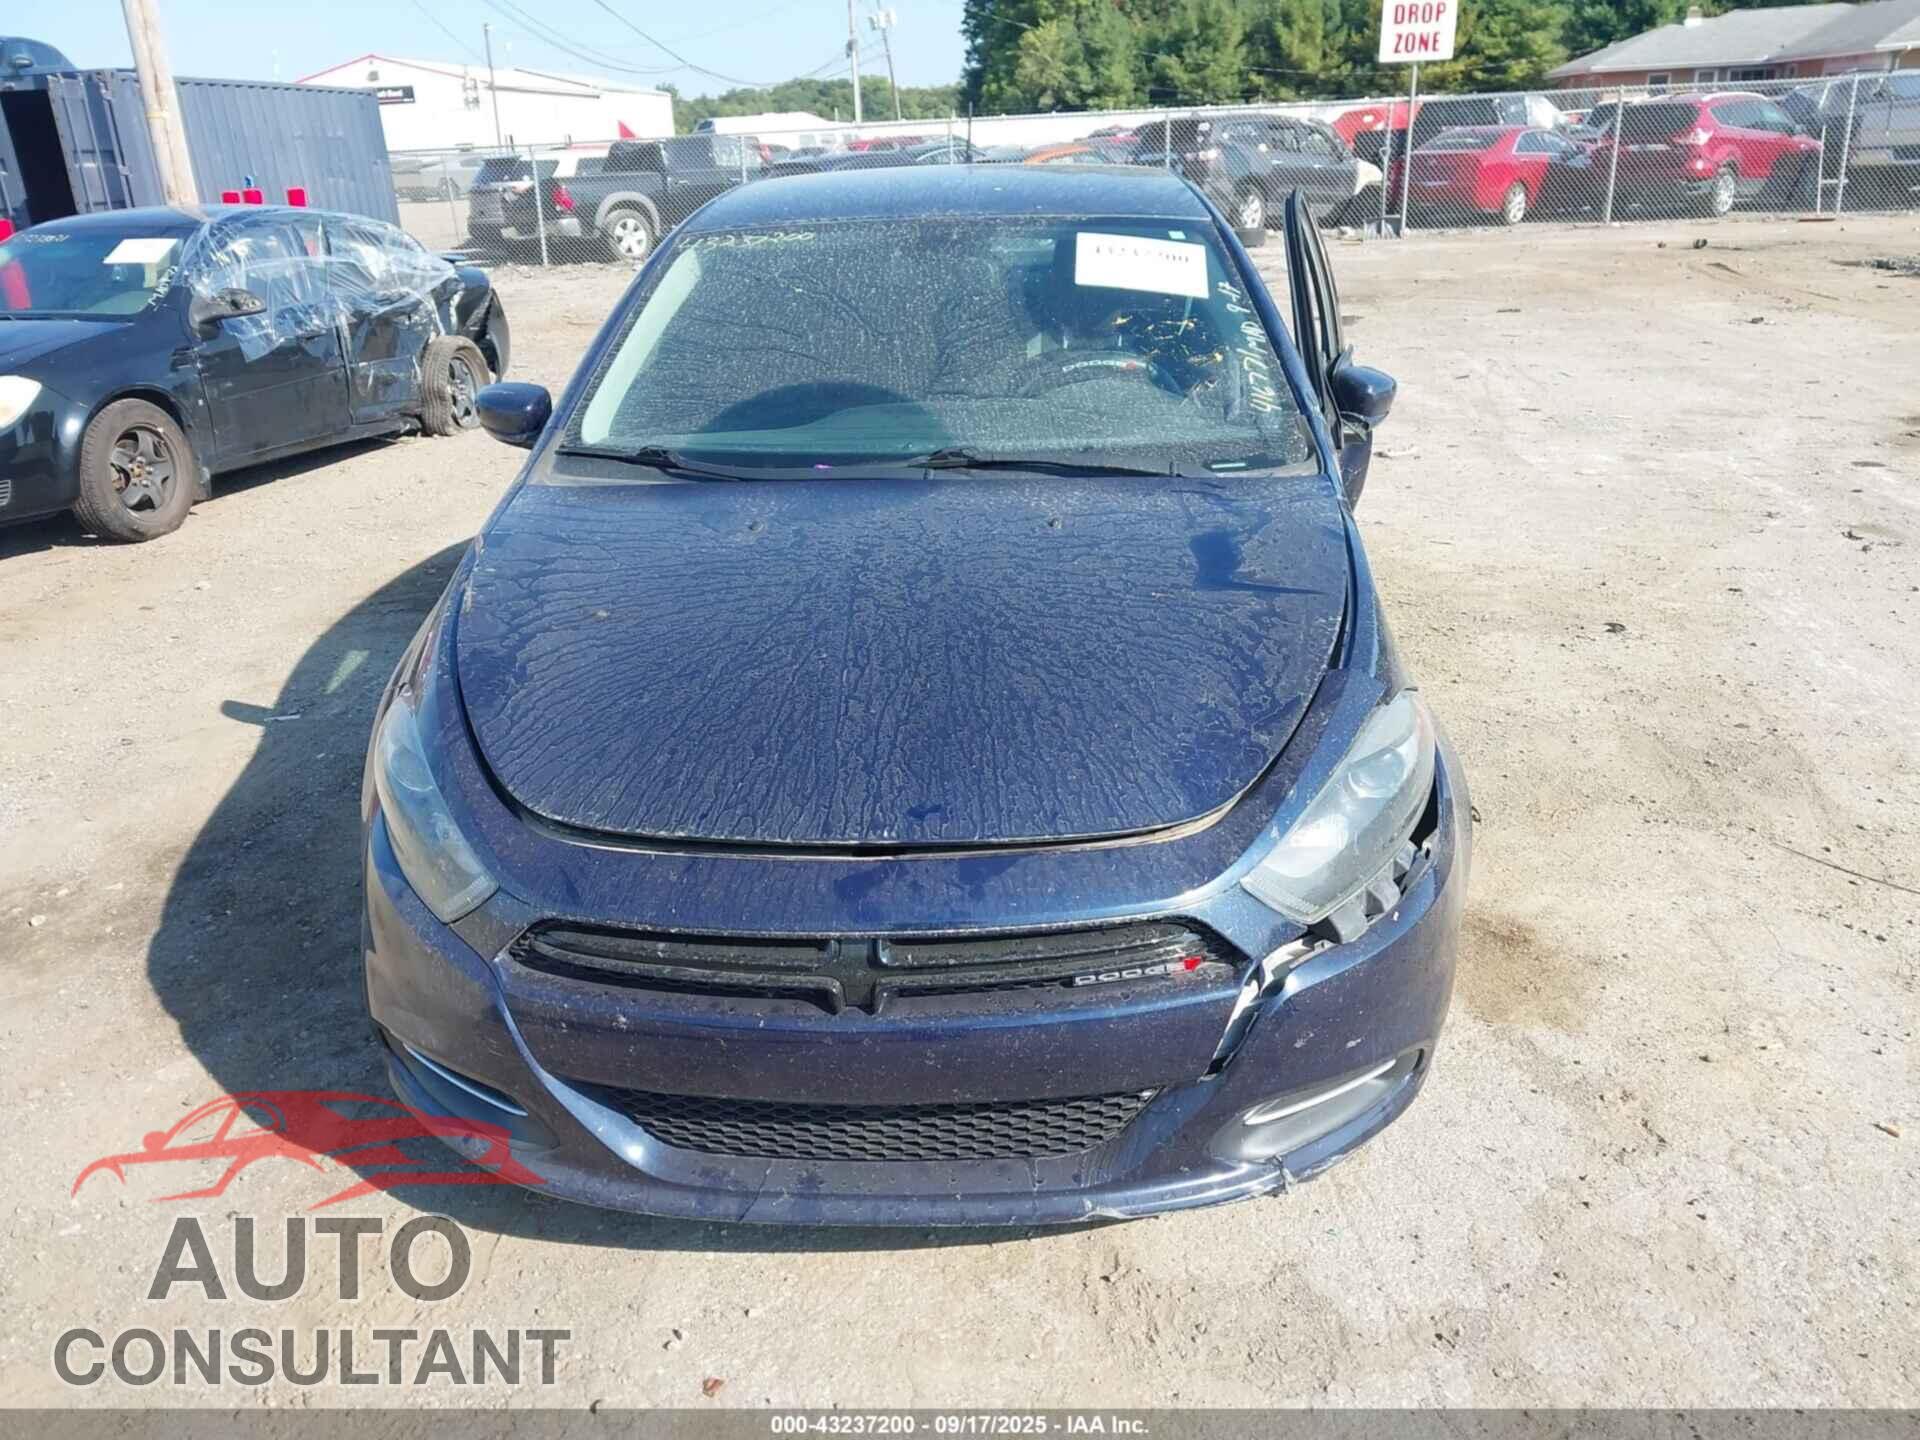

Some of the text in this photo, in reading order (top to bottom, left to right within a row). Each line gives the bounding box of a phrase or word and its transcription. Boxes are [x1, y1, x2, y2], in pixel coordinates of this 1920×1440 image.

[1394, 3, 1446, 24] DROP
[1393, 32, 1440, 53] ZONE
[1074, 961, 1182, 986] DODG
